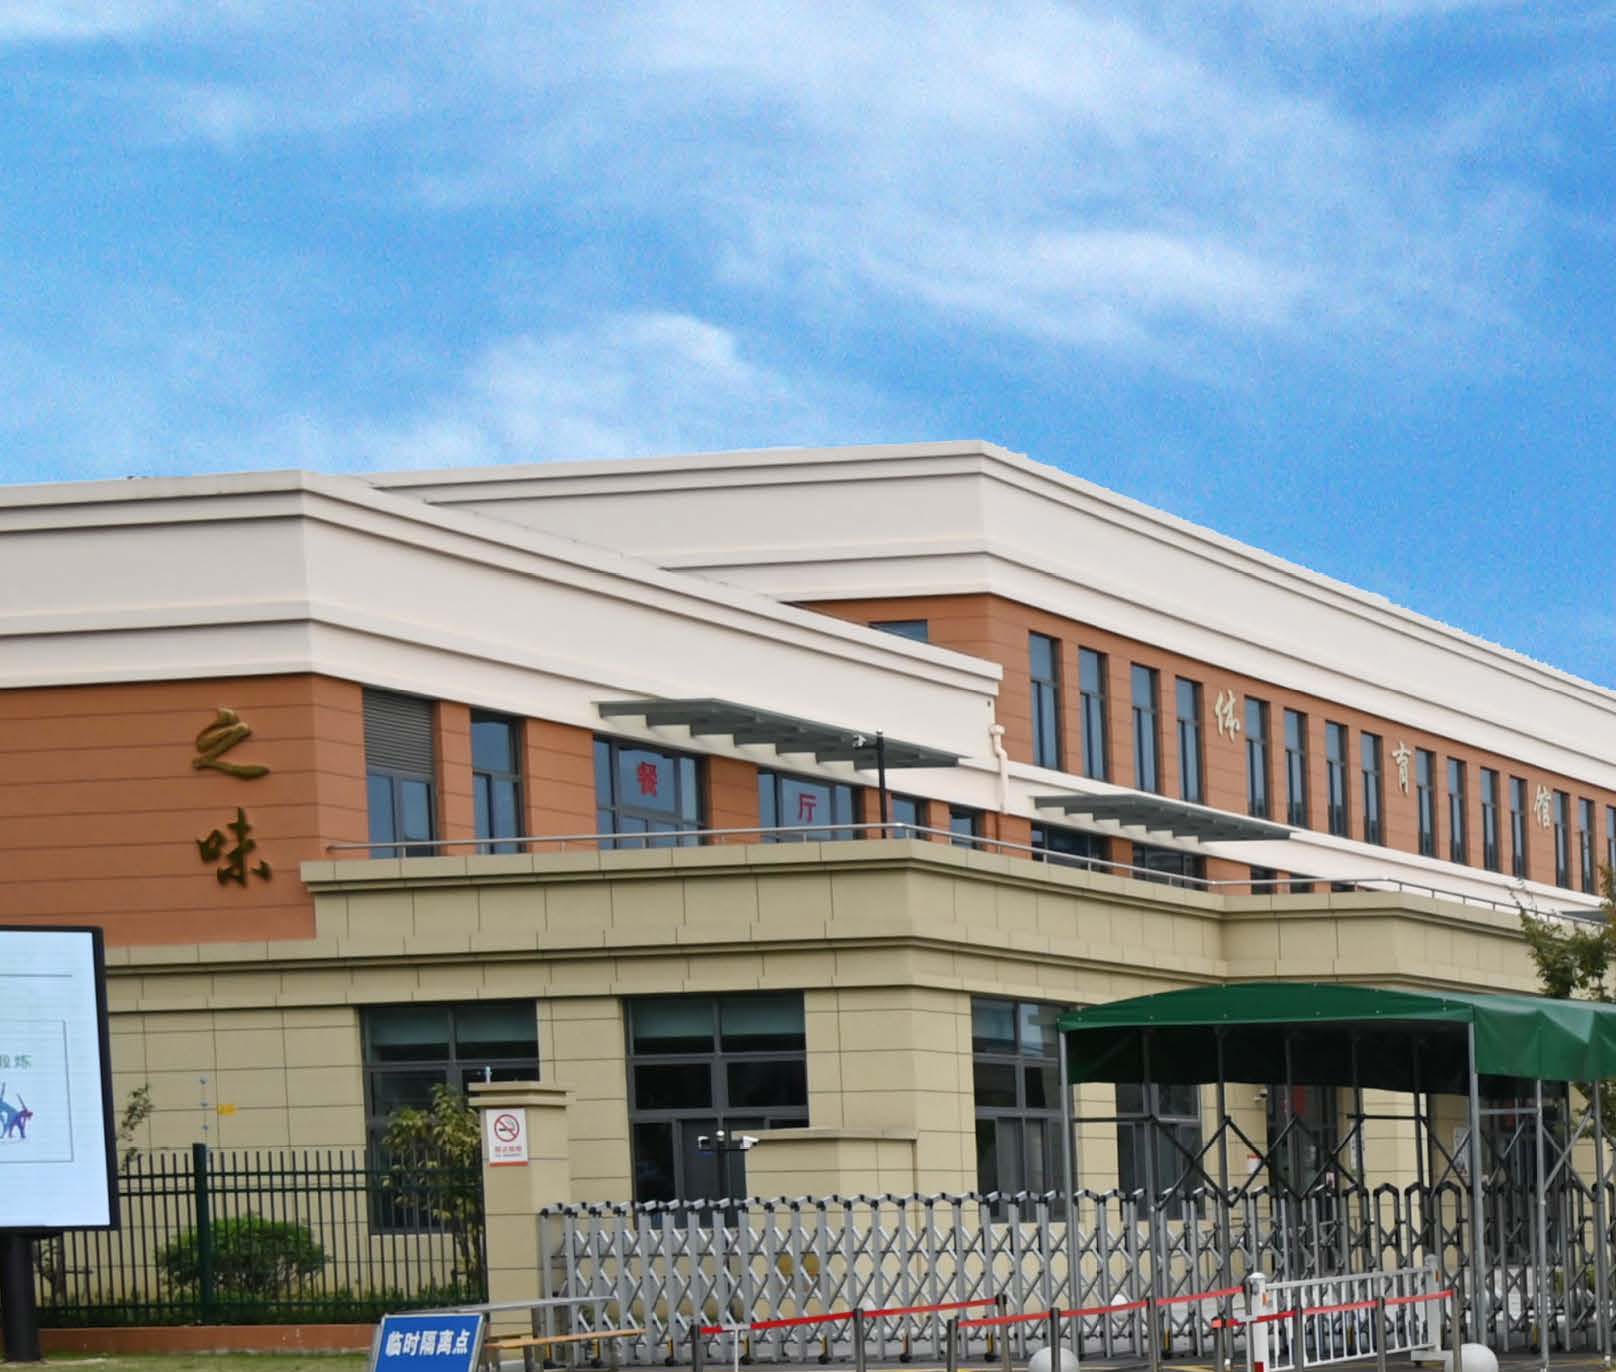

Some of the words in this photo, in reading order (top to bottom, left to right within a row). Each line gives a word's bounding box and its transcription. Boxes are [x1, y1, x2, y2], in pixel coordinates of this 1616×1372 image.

[385, 1328, 471, 1358] 临时隔离点
